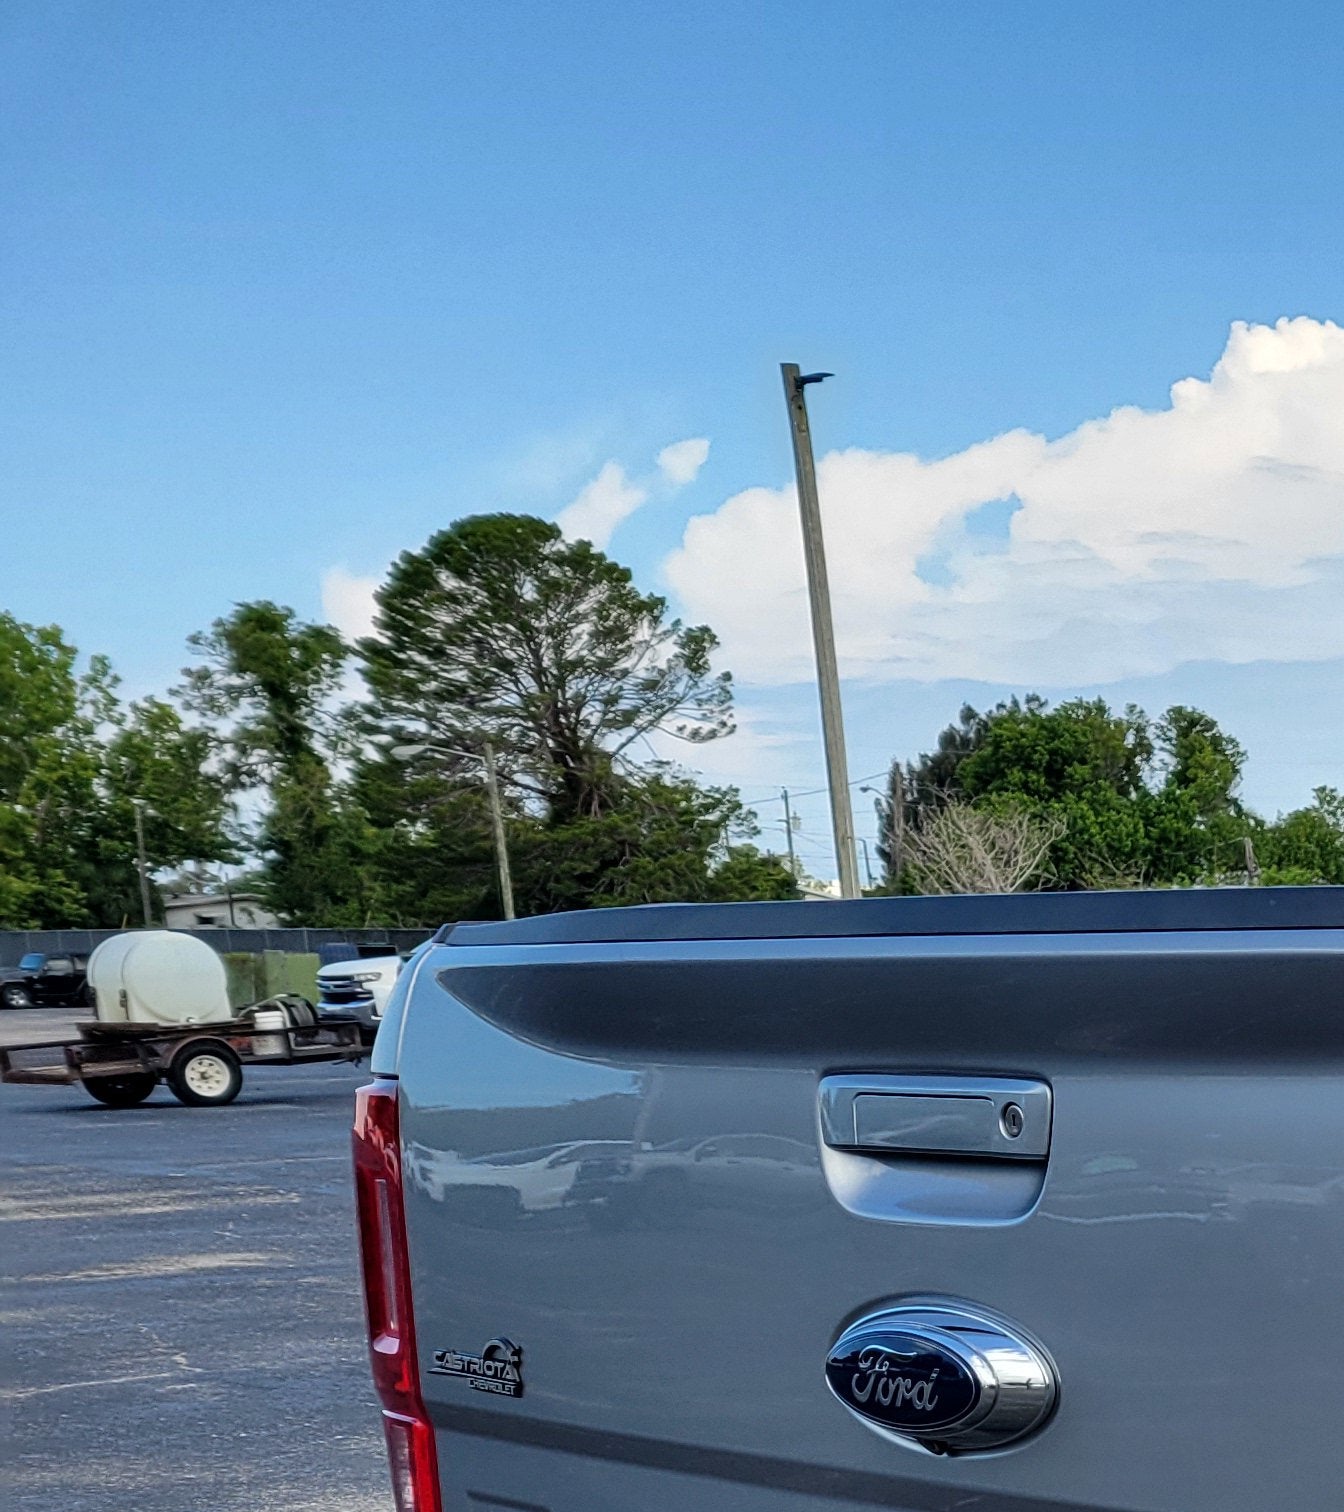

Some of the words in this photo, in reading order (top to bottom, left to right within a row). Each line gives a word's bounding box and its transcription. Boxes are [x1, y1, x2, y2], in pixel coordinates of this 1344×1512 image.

[433, 1350, 520, 1382] CASTRIOTA
[851, 1344, 940, 1412] Ford
[466, 1378, 517, 1395] CHEVROLET
